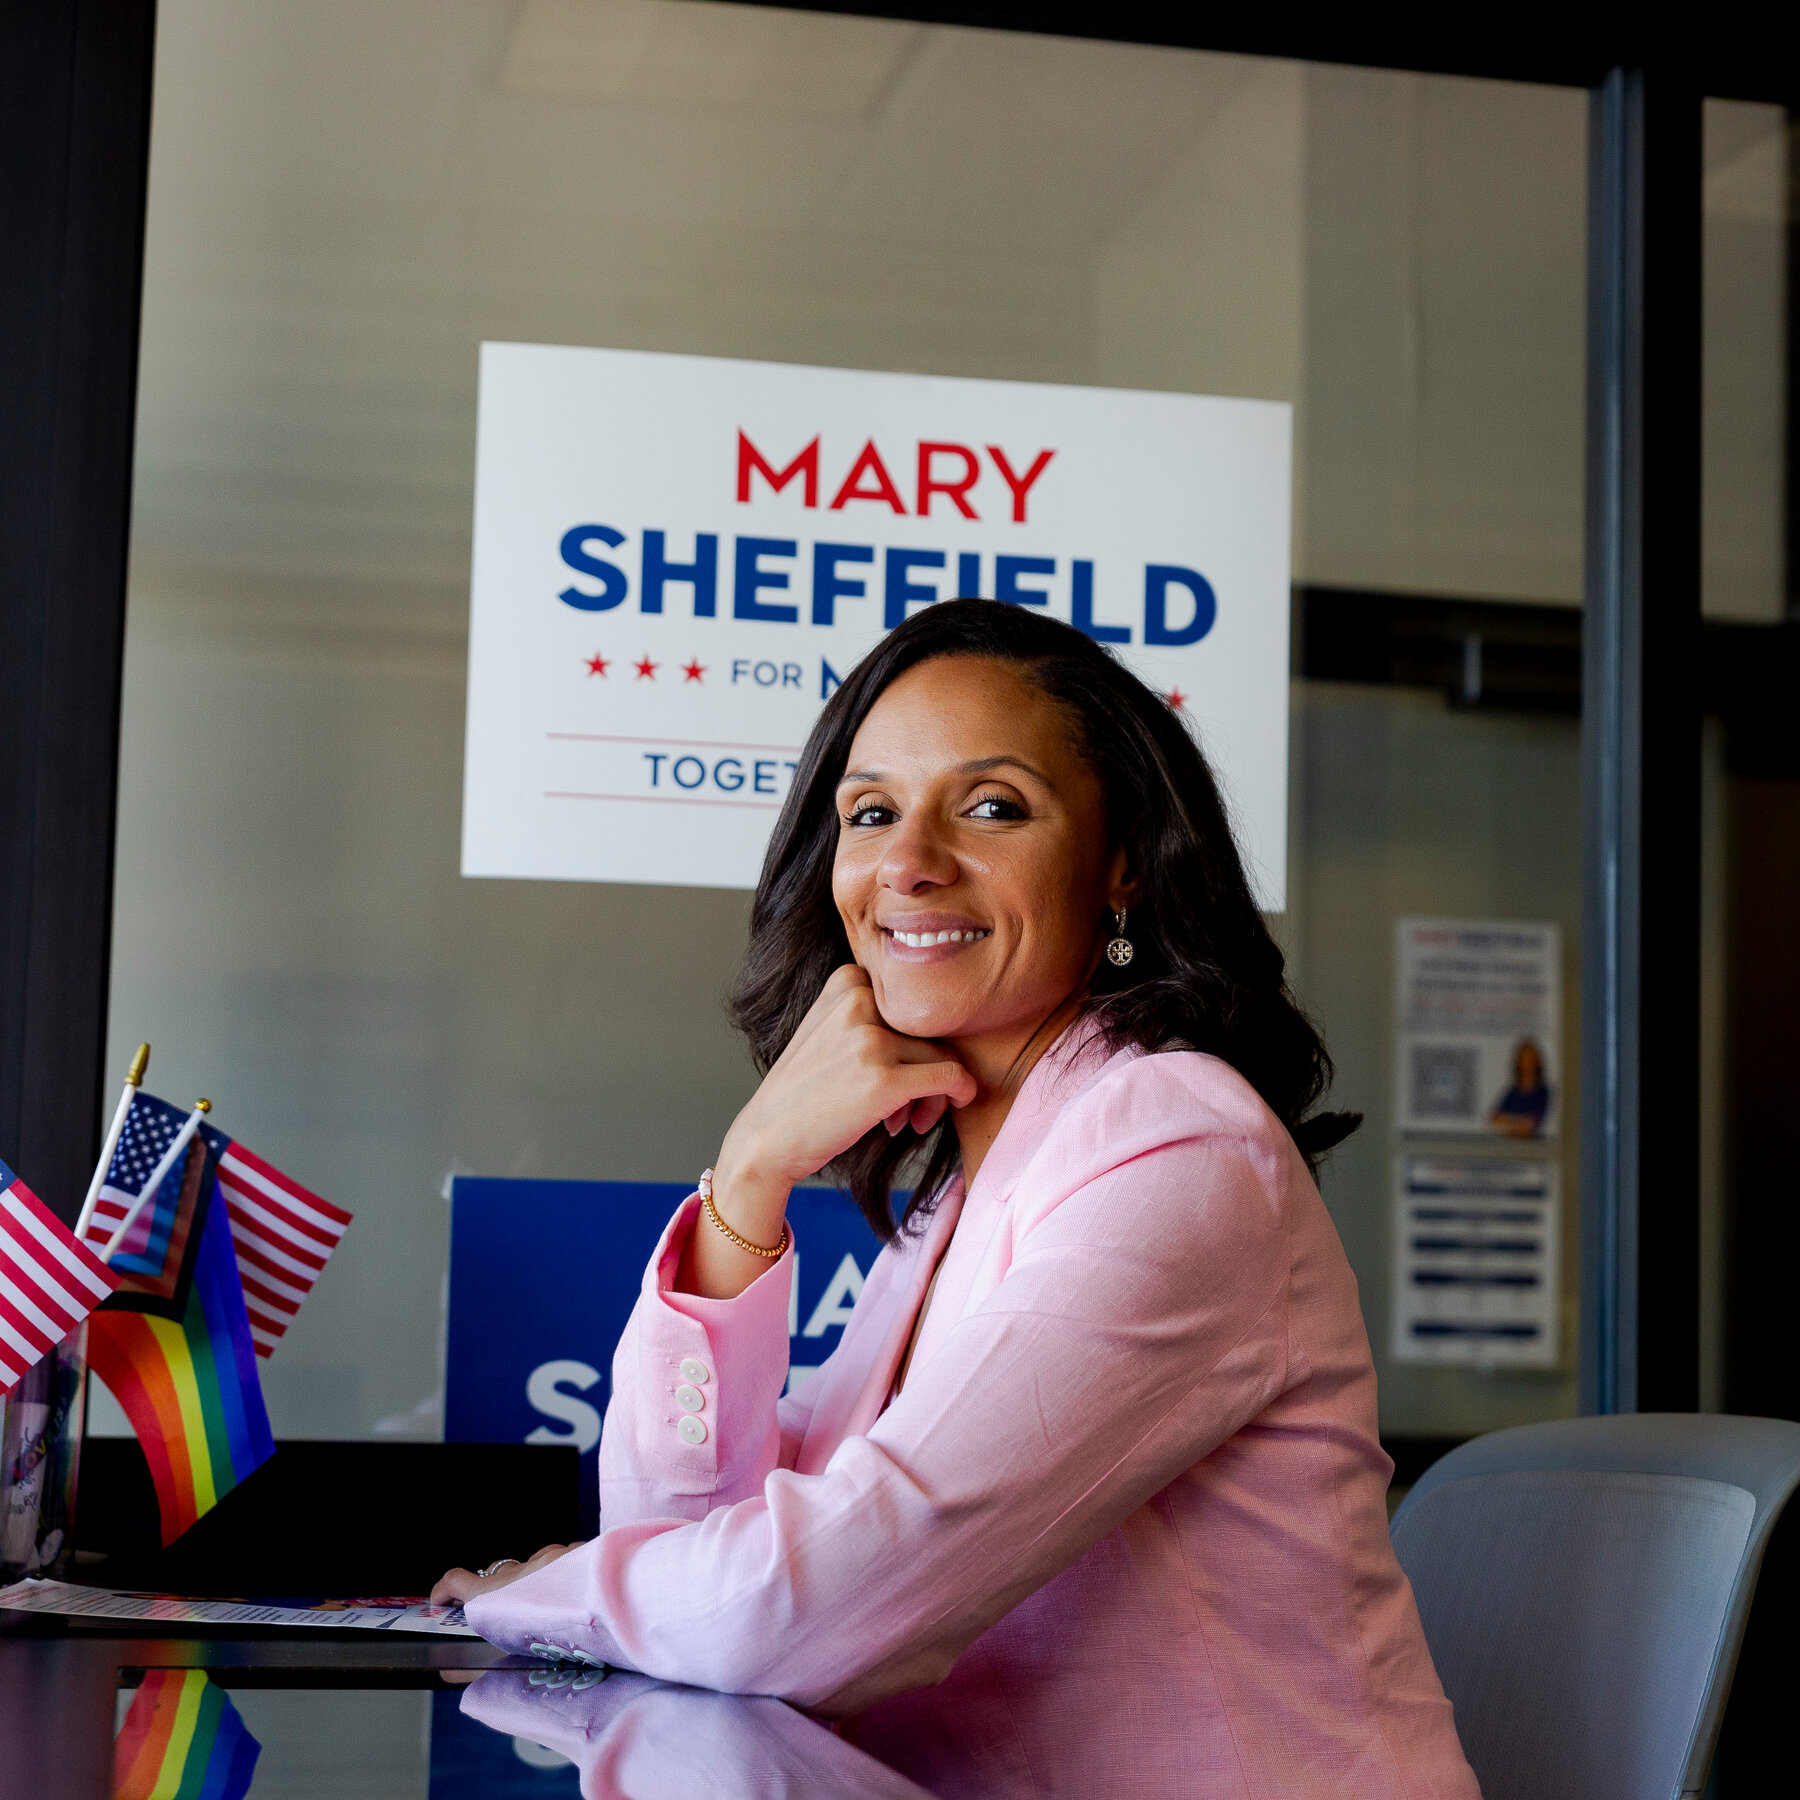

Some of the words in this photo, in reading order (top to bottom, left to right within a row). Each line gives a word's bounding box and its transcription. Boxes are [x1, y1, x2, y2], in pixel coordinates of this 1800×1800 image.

[736, 427, 1055, 524] MARY
[558, 523, 1217, 647] SHEFFIELD
[731, 658, 803, 689] FOR
